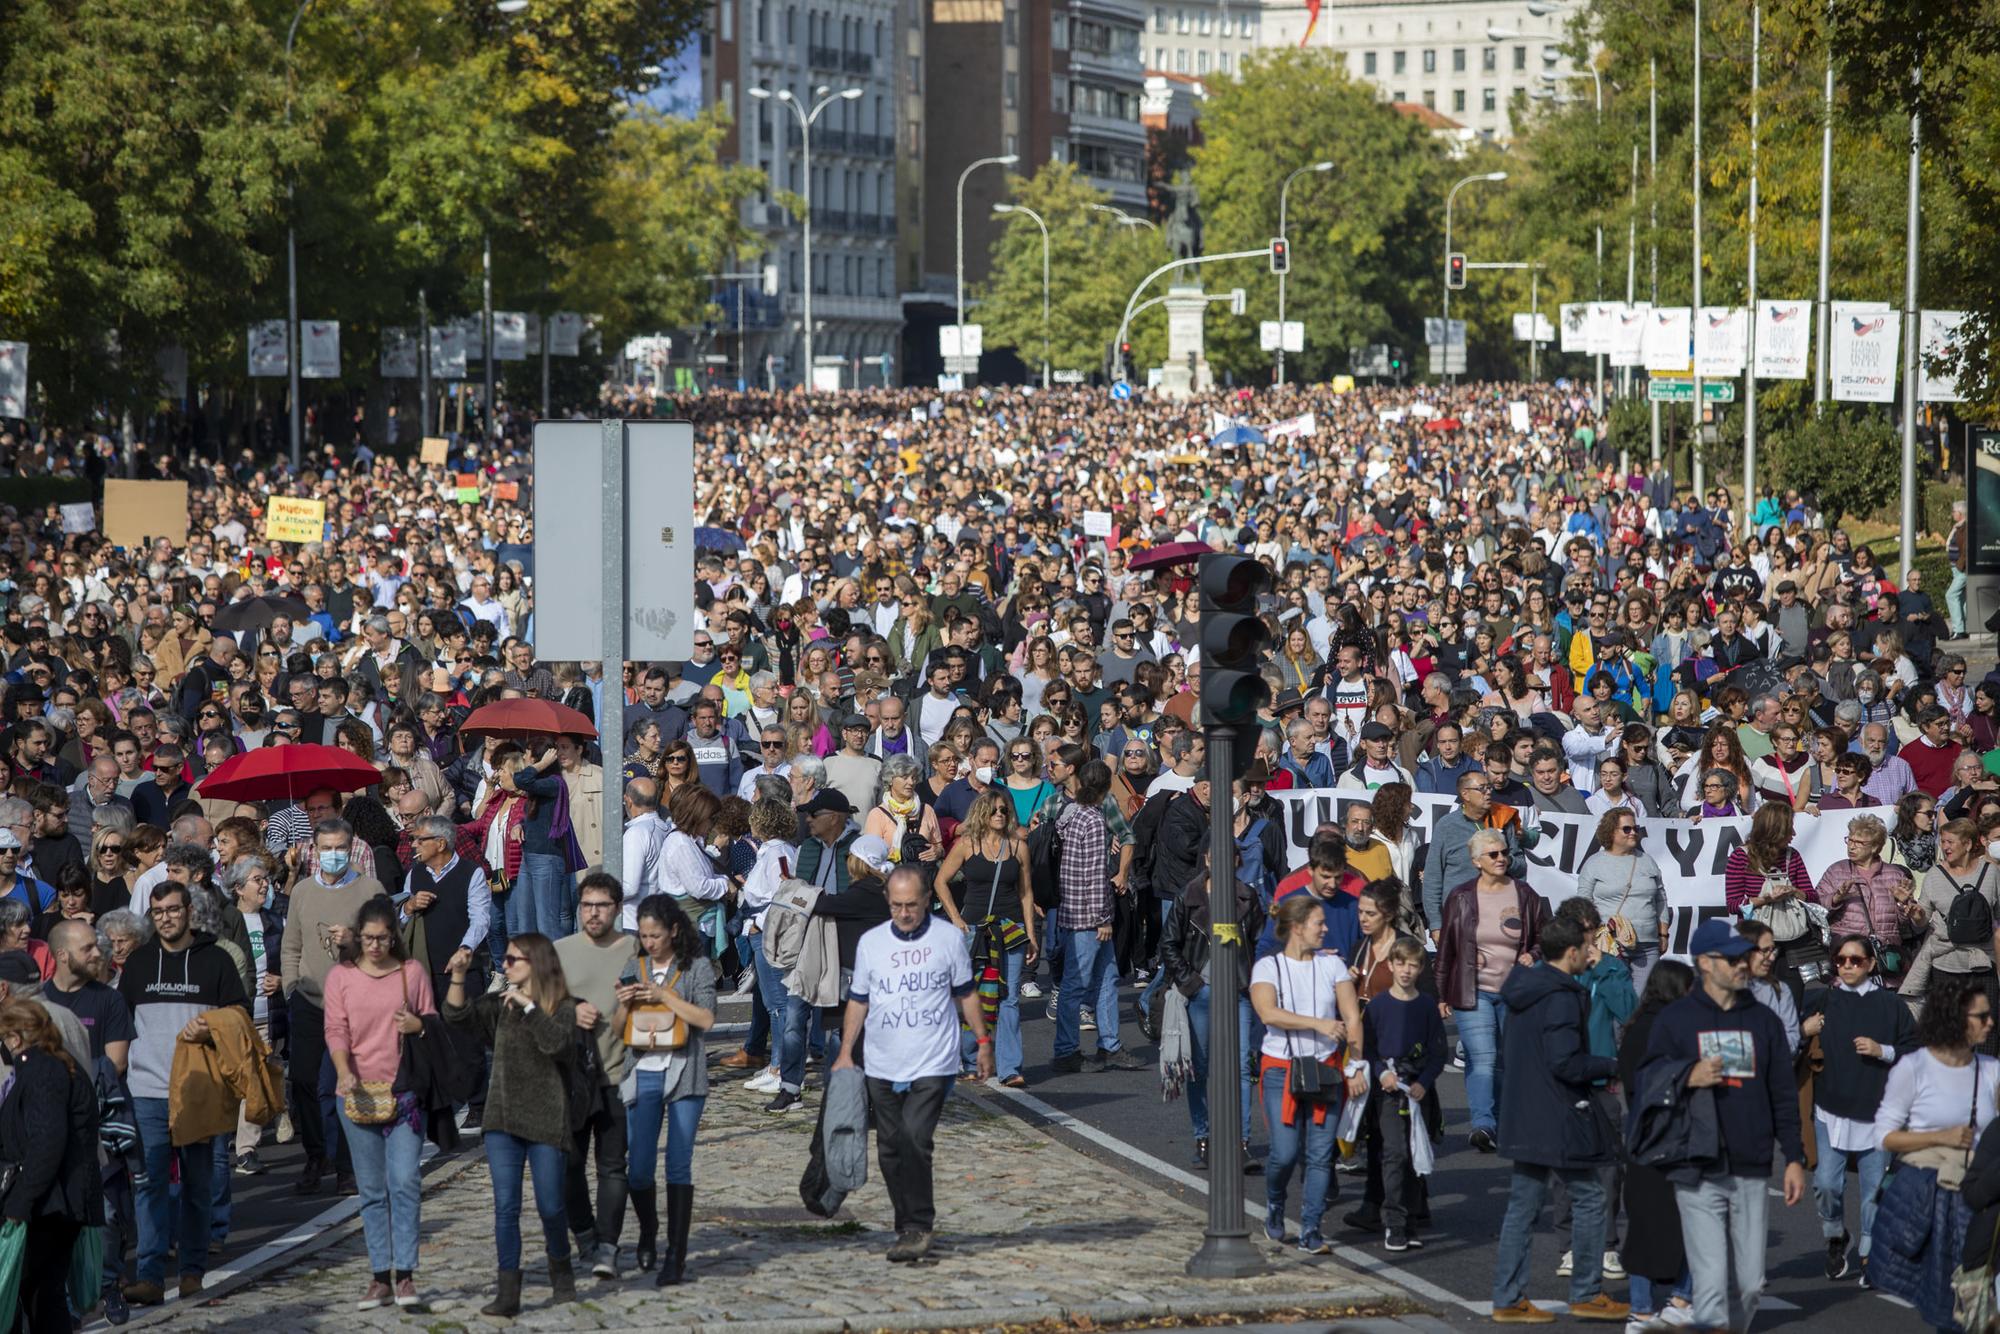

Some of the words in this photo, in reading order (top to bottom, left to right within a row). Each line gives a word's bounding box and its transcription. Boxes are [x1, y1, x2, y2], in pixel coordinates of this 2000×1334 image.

[1722, 574, 1753, 591] NYC
[891, 947, 932, 968] STOP
[877, 978, 893, 995] AL
[900, 995, 917, 1010] DE
[881, 1010, 944, 1029] AYUSO
